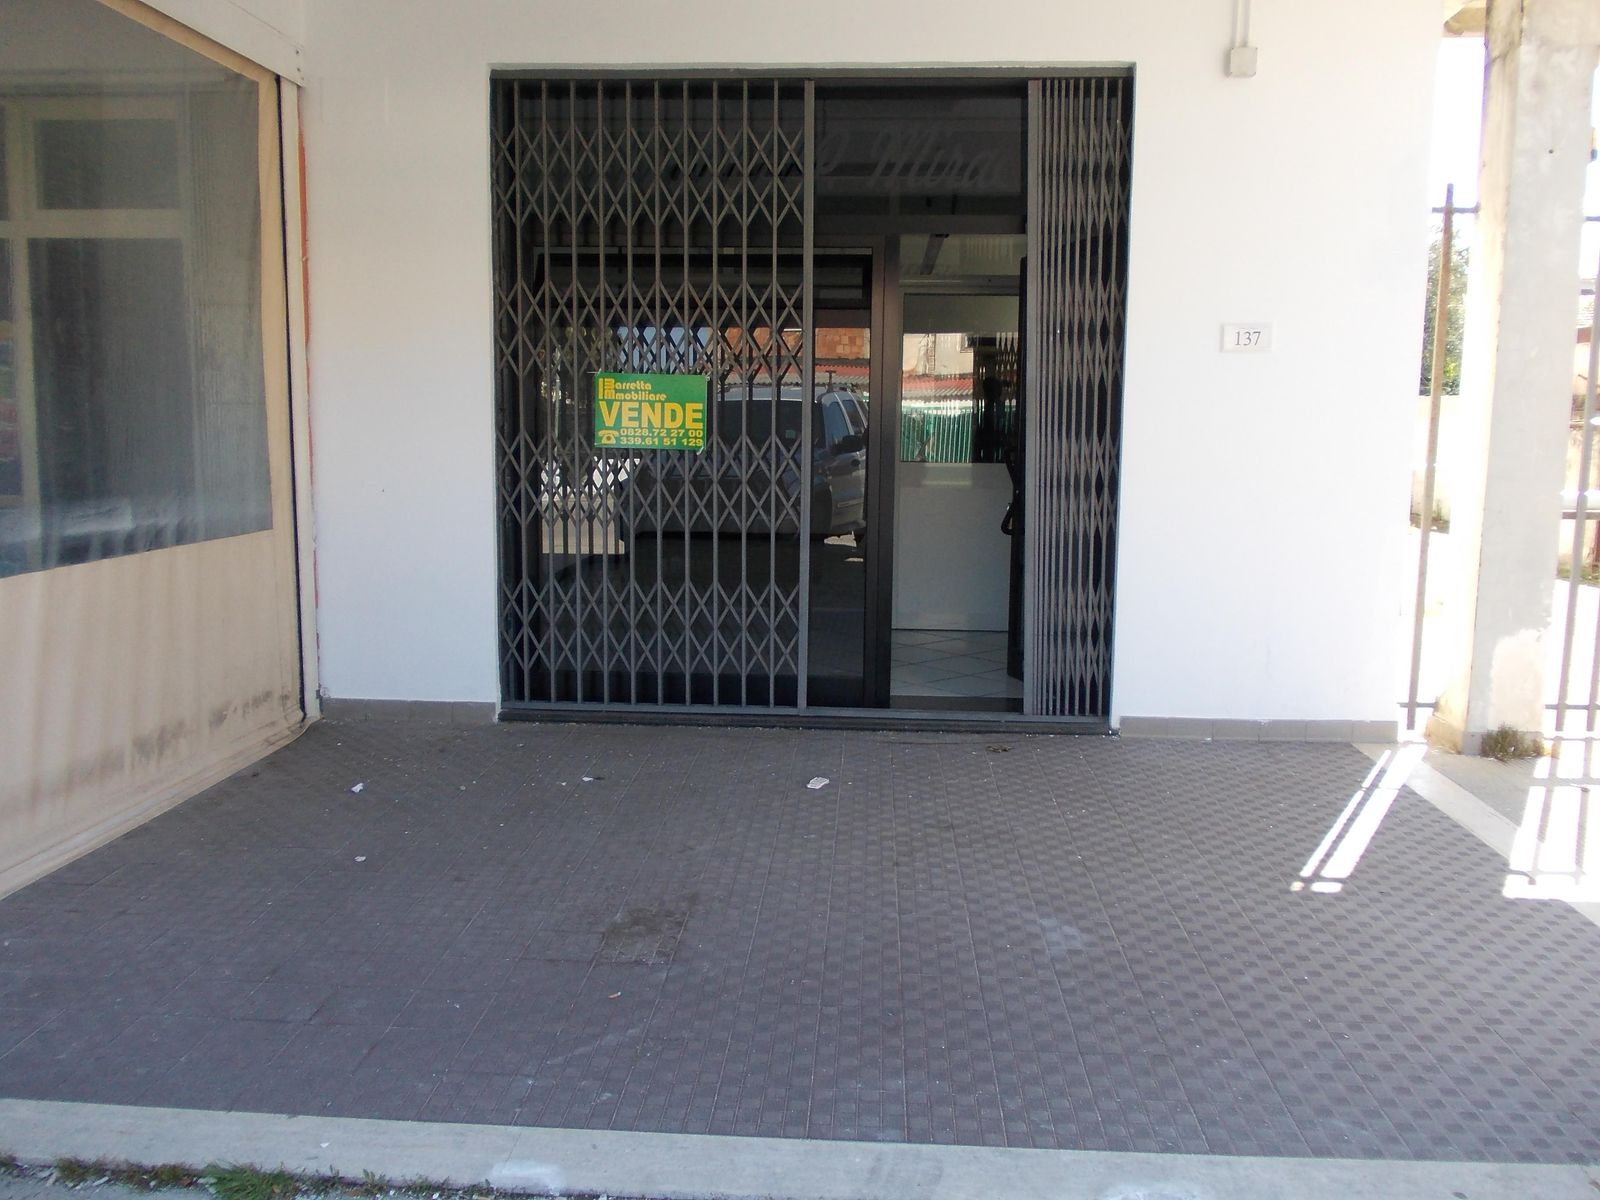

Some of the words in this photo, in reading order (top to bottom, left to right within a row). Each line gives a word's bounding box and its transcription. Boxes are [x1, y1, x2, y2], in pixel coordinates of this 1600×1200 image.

[1235, 331, 1261, 346] 137
[598, 401, 703, 429] VENDE
[620, 428, 667, 437] 0828.72
[670, 429, 684, 437] 27
[620, 437, 658, 446] 339.61
[663, 437, 677, 446] 51
[683, 438, 704, 446] 129
